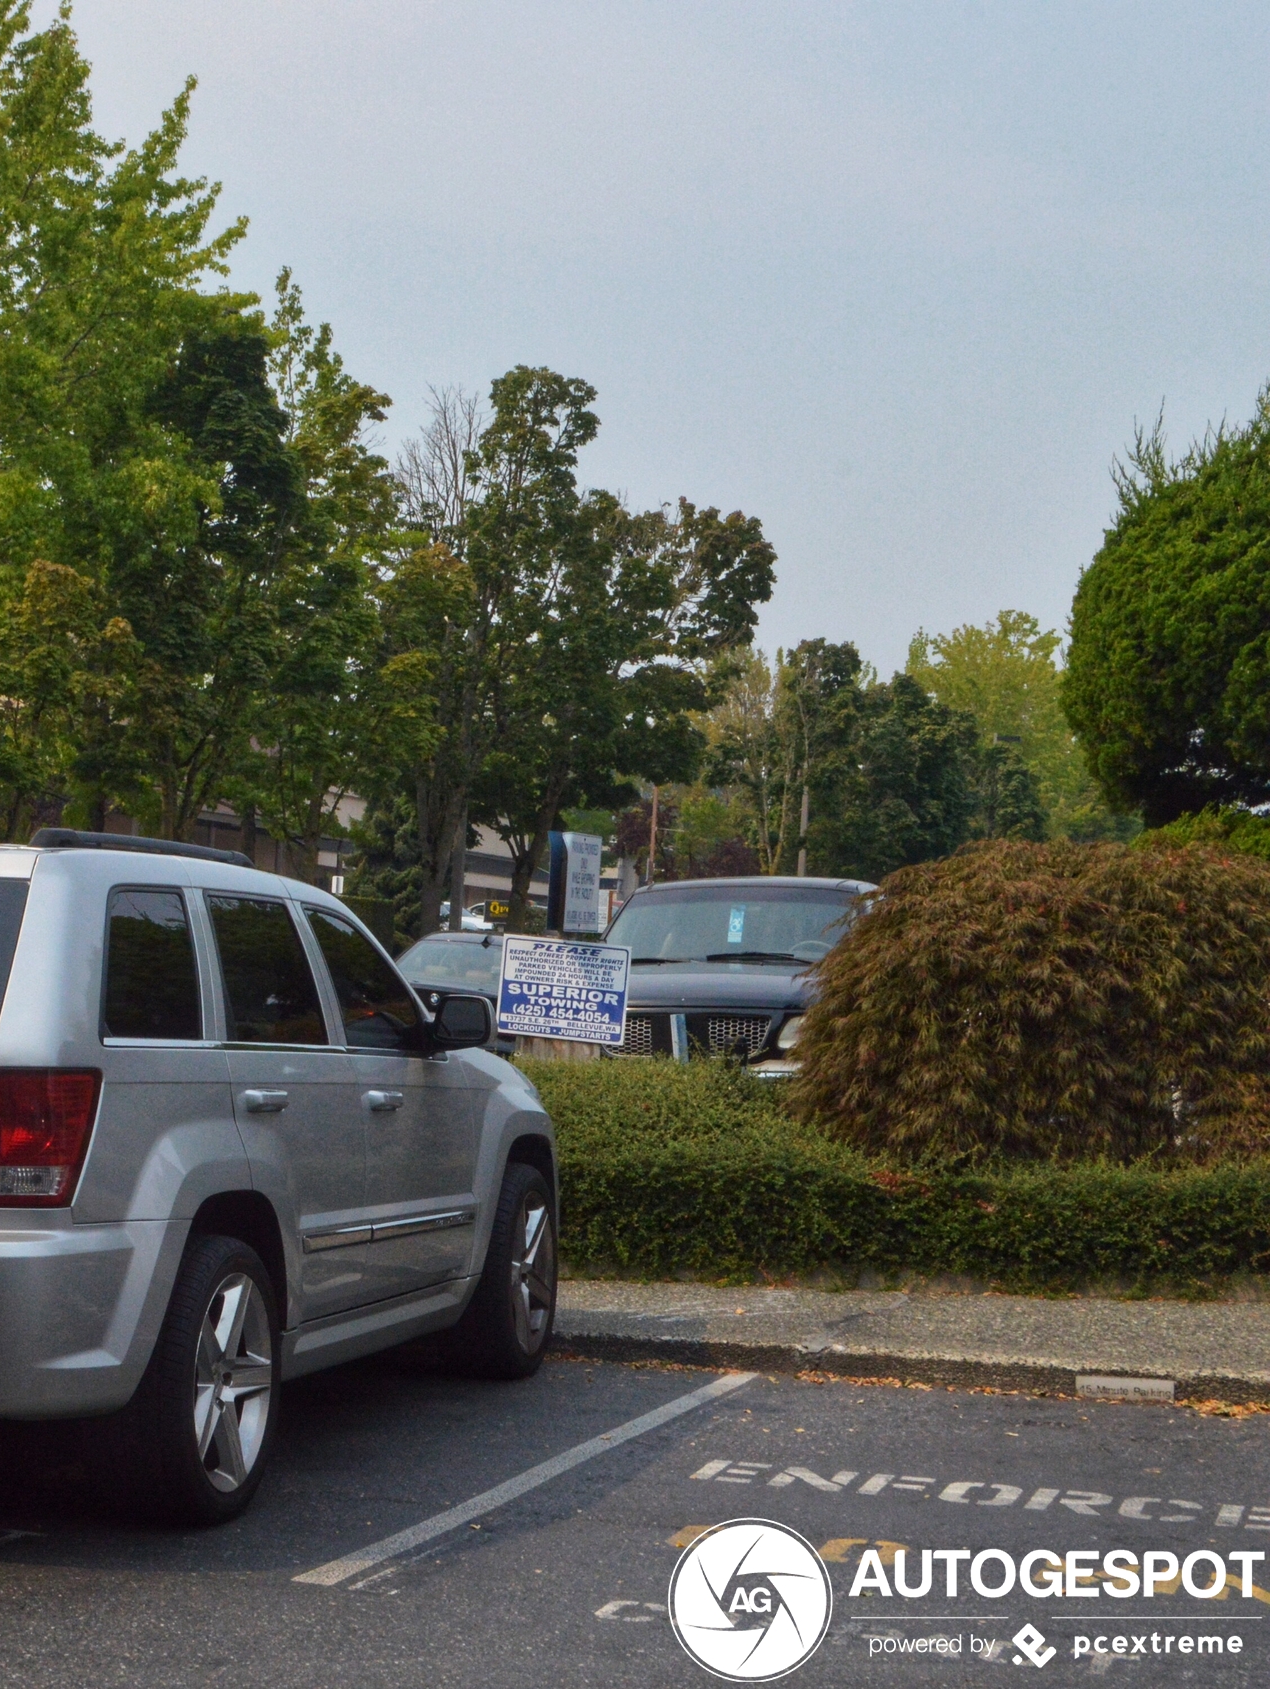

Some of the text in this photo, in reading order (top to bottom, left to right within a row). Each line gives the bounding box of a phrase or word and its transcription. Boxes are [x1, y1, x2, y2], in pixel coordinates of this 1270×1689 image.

[509, 949, 537, 957] RESPECT
[565, 953, 599, 963] PROPERTY
[533, 943, 602, 957] PLEASE
[510, 955, 564, 966] UNAUTHORIZED
[578, 961, 622, 971] IMPROPERLY
[518, 962, 547, 970] PARKED
[548, 965, 582, 973] VEHICLES
[514, 968, 556, 977] IMPOUNDED
[568, 973, 592, 981] HOURS
[524, 975, 555, 983] OWNERS
[582, 980, 614, 989] EXPENSE
[508, 983, 619, 1006] SUPERIOR
[527, 995, 598, 1011] TOWING
[506, 1014, 526, 1023] 13737
[527, 1016, 541, 1024] S.E.
[512, 1003, 610, 1024] (425) 454-4054
[508, 1023, 611, 1040] LOCKOUTS JUMPSTARTS
[1096, 1385, 1129, 1396] Minute
[1133, 1387, 1171, 1399] Parking
